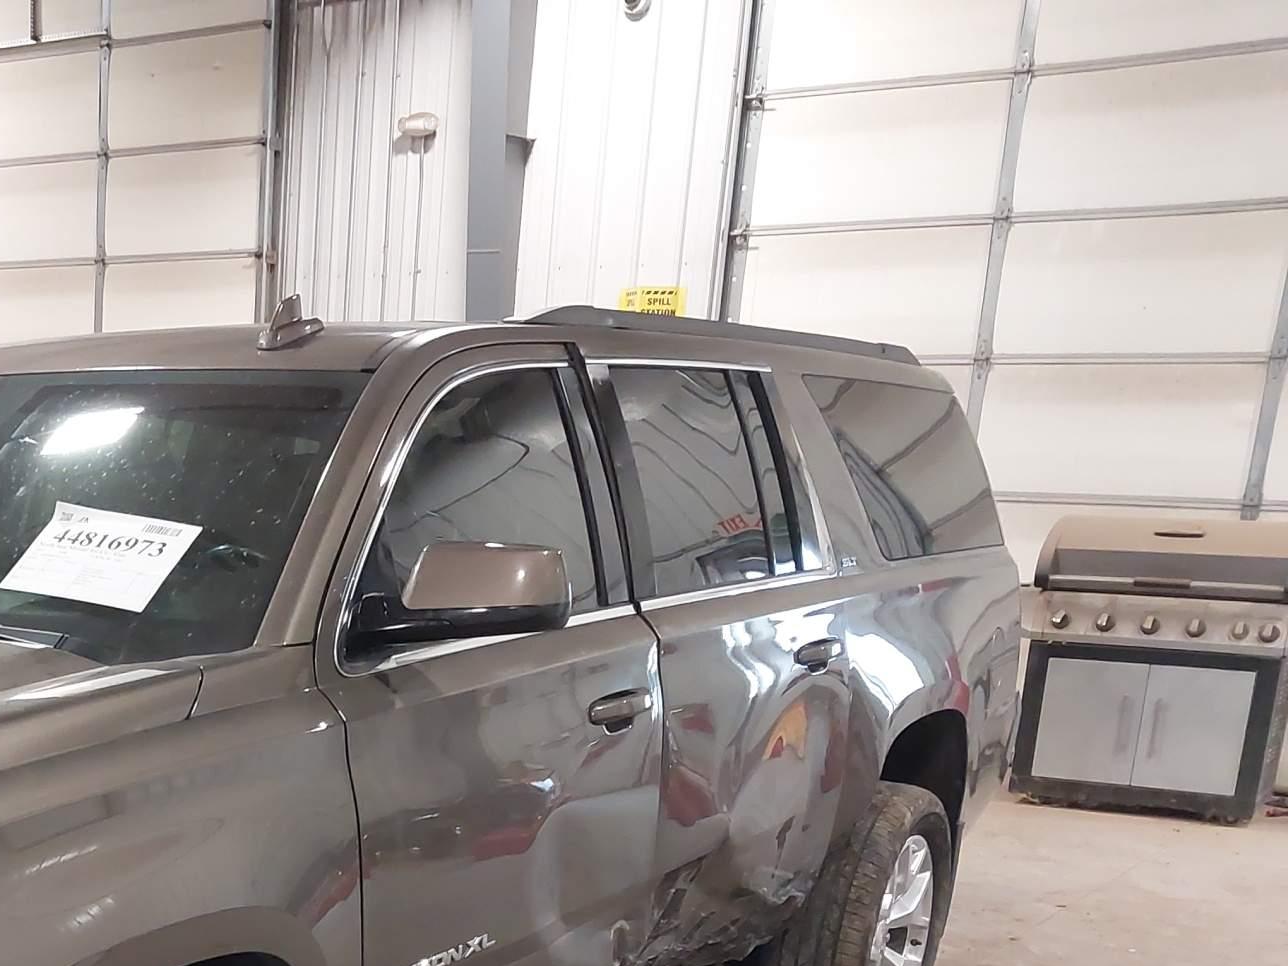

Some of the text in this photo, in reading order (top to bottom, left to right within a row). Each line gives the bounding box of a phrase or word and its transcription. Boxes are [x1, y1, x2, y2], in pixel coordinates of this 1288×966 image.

[647, 297, 672, 306] SPILL
[52, 528, 168, 558] 44816973
[464, 933, 496, 958] XL
